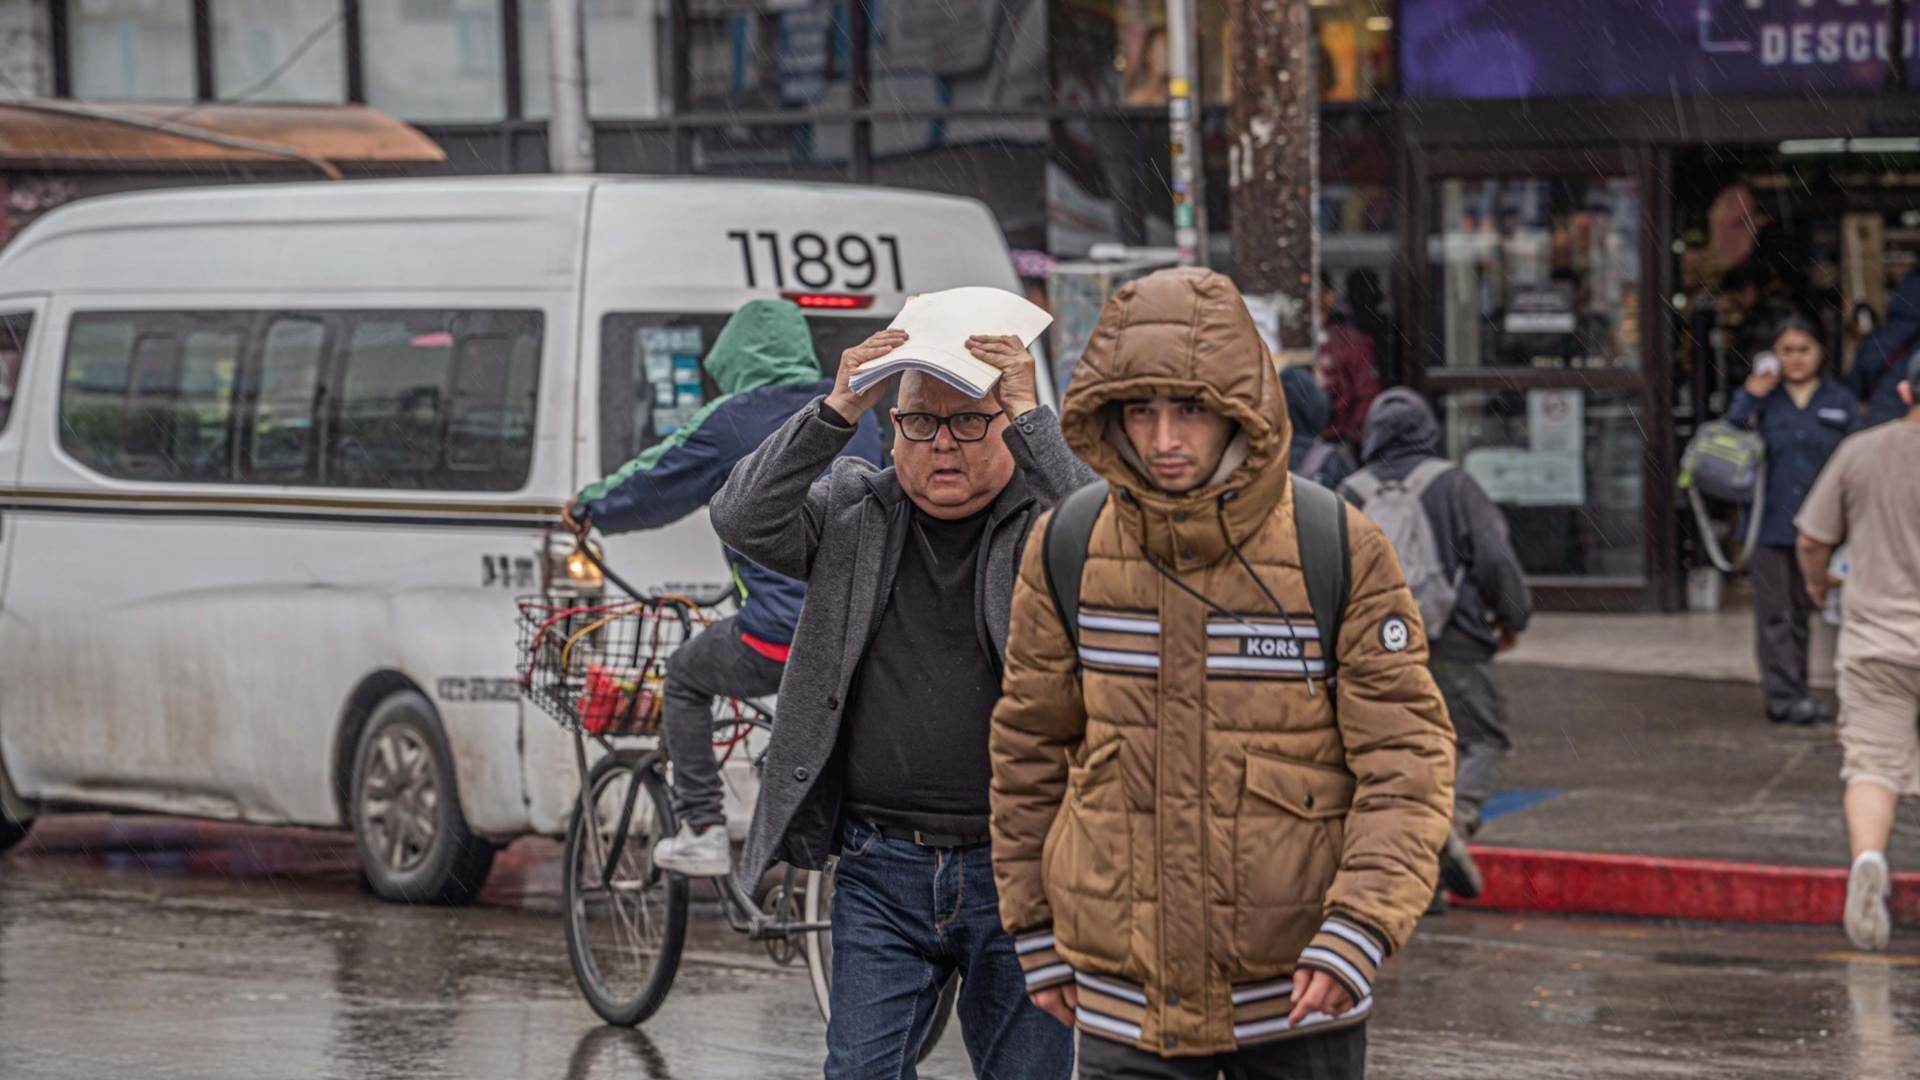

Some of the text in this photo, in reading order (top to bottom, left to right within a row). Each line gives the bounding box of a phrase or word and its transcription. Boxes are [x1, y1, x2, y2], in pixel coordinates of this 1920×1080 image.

[1760, 20, 1920, 64] DESCU
[728, 231, 904, 293] 11891
[1247, 639, 1299, 657] KORS
